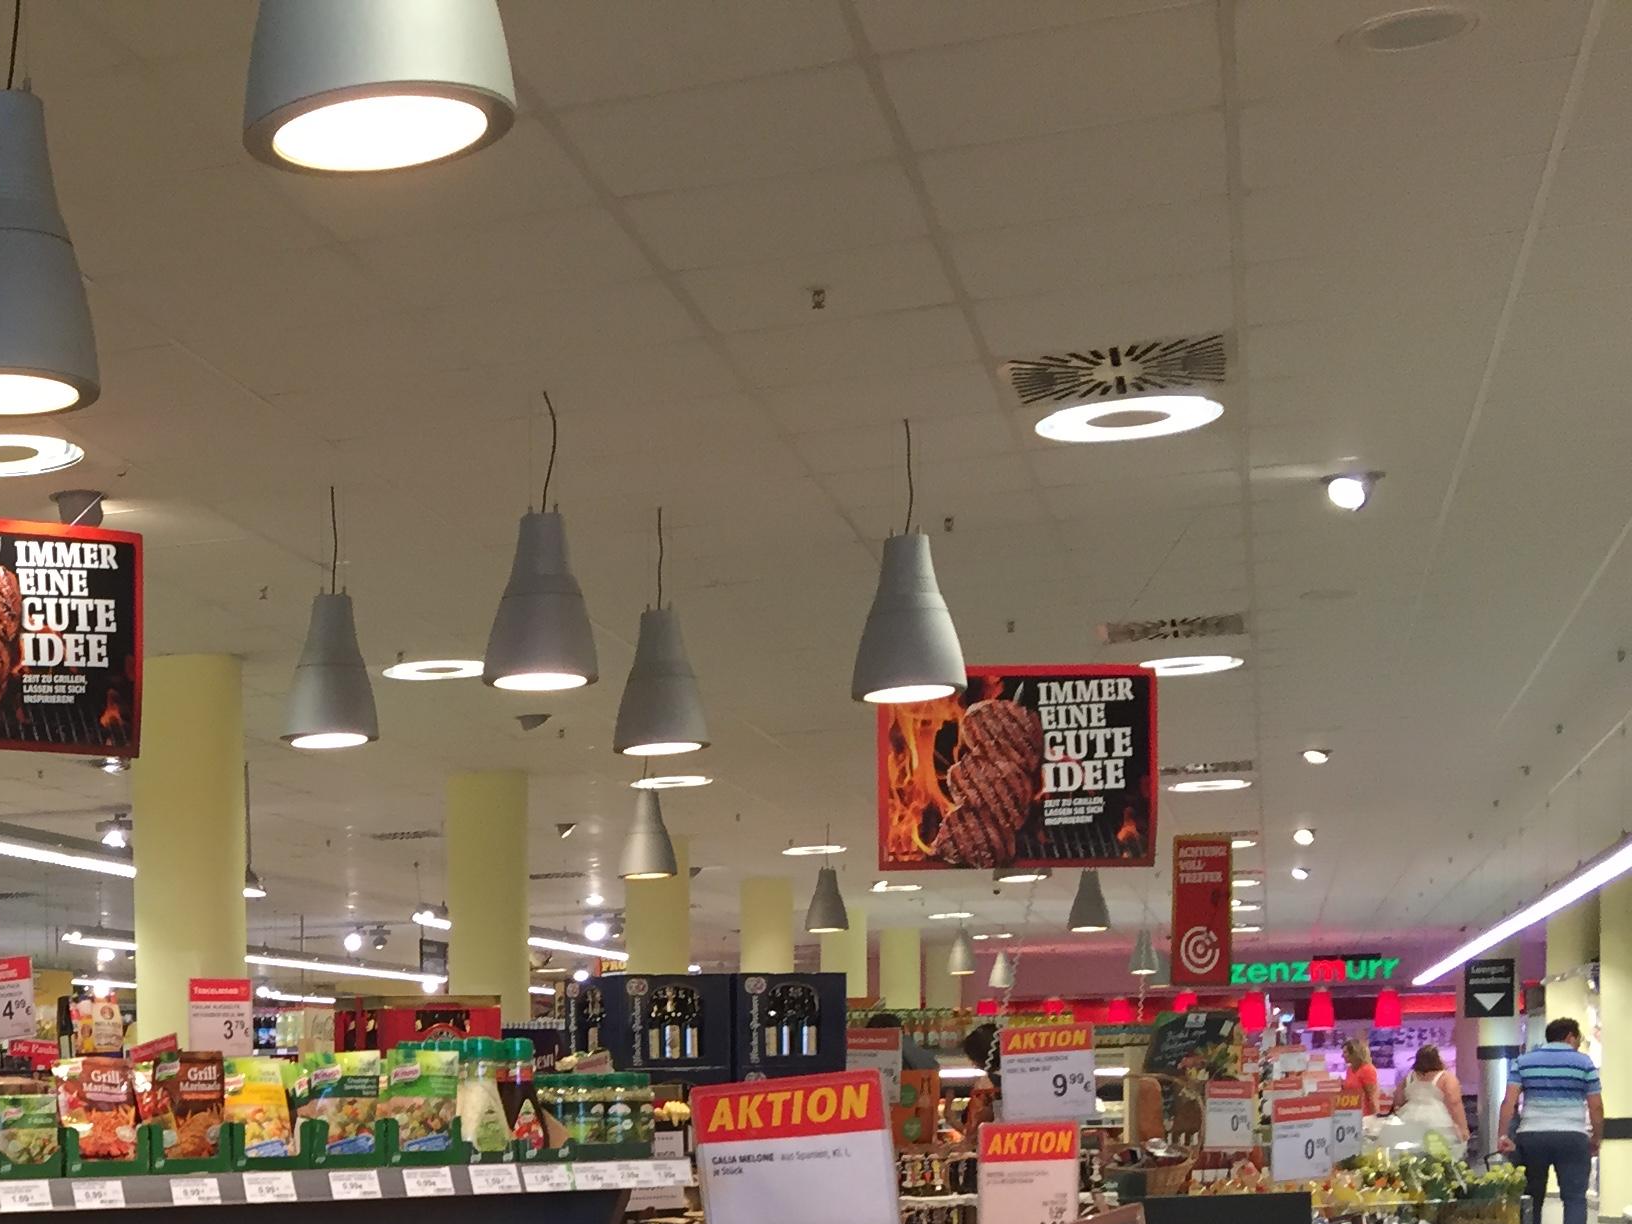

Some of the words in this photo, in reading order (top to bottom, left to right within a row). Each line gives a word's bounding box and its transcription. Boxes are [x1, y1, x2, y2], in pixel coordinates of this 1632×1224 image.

[14, 540, 119, 570] IMMER
[16, 568, 89, 597] EINE
[21, 597, 117, 633] GUTE
[21, 633, 109, 668] IDEE
[1037, 678, 1135, 705] IMMER
[1038, 702, 1107, 730] EINE
[1044, 727, 1133, 761] GUTE
[1042, 759, 1126, 792] IDEE
[1008, 1029, 1087, 1050] AKTION
[82, 1081, 128, 1092] Marinad
[708, 1083, 870, 1133] AKTION
[987, 1130, 1073, 1155] AKTION
